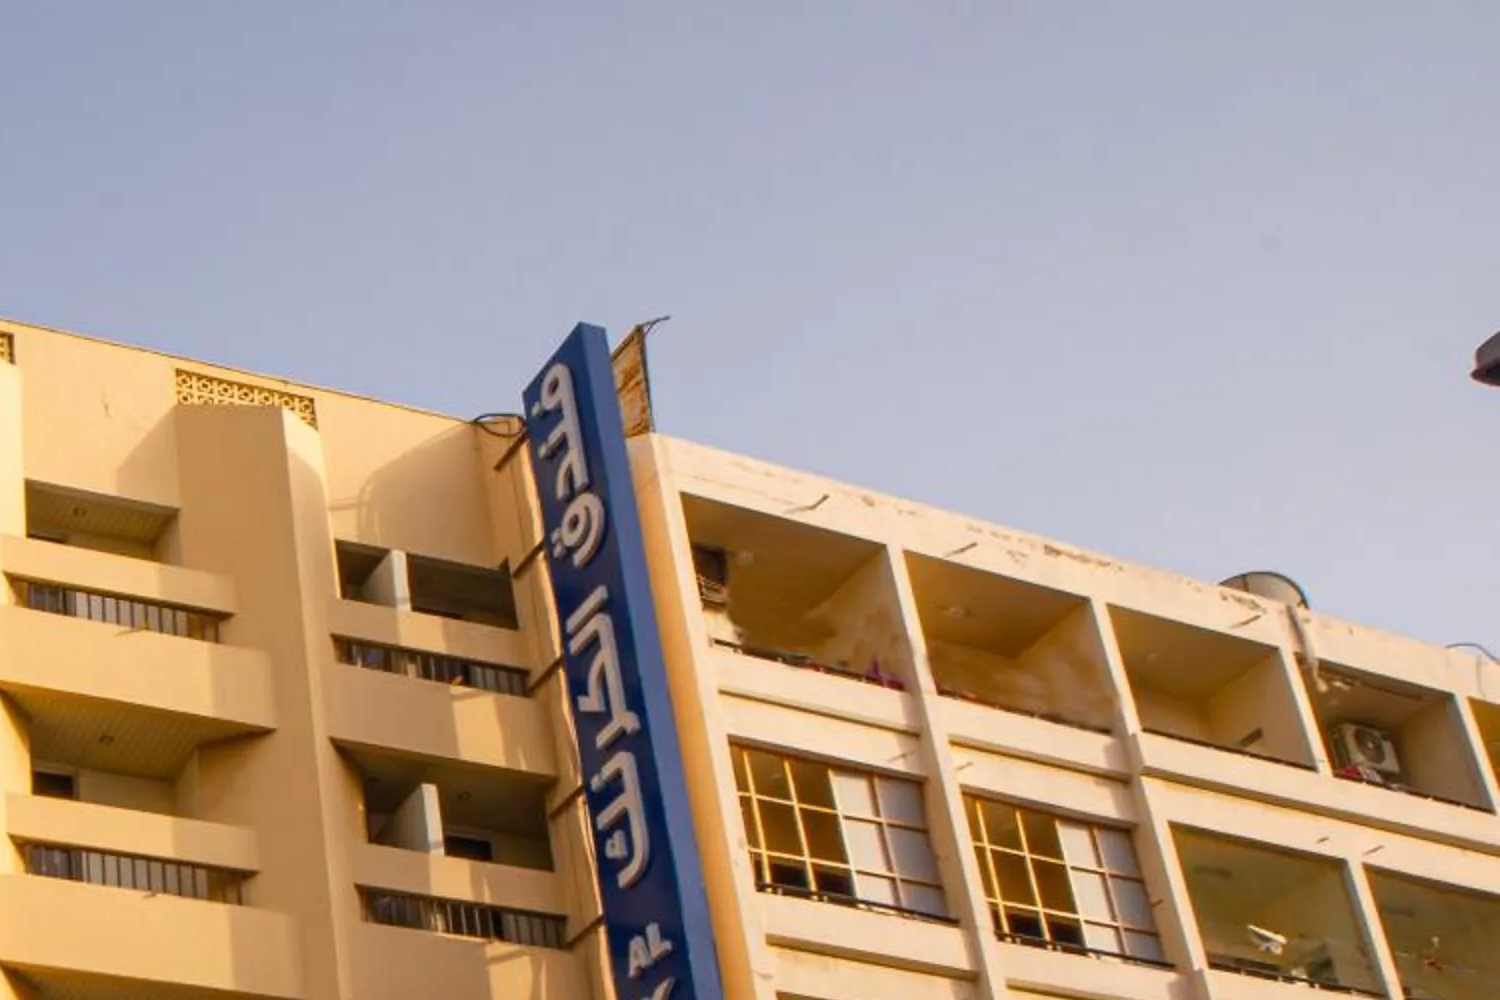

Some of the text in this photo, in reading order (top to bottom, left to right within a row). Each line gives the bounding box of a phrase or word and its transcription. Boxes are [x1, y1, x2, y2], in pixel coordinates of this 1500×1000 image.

[531, 362, 651, 890] فندق الكرنك
[626, 920, 674, 979] AL
